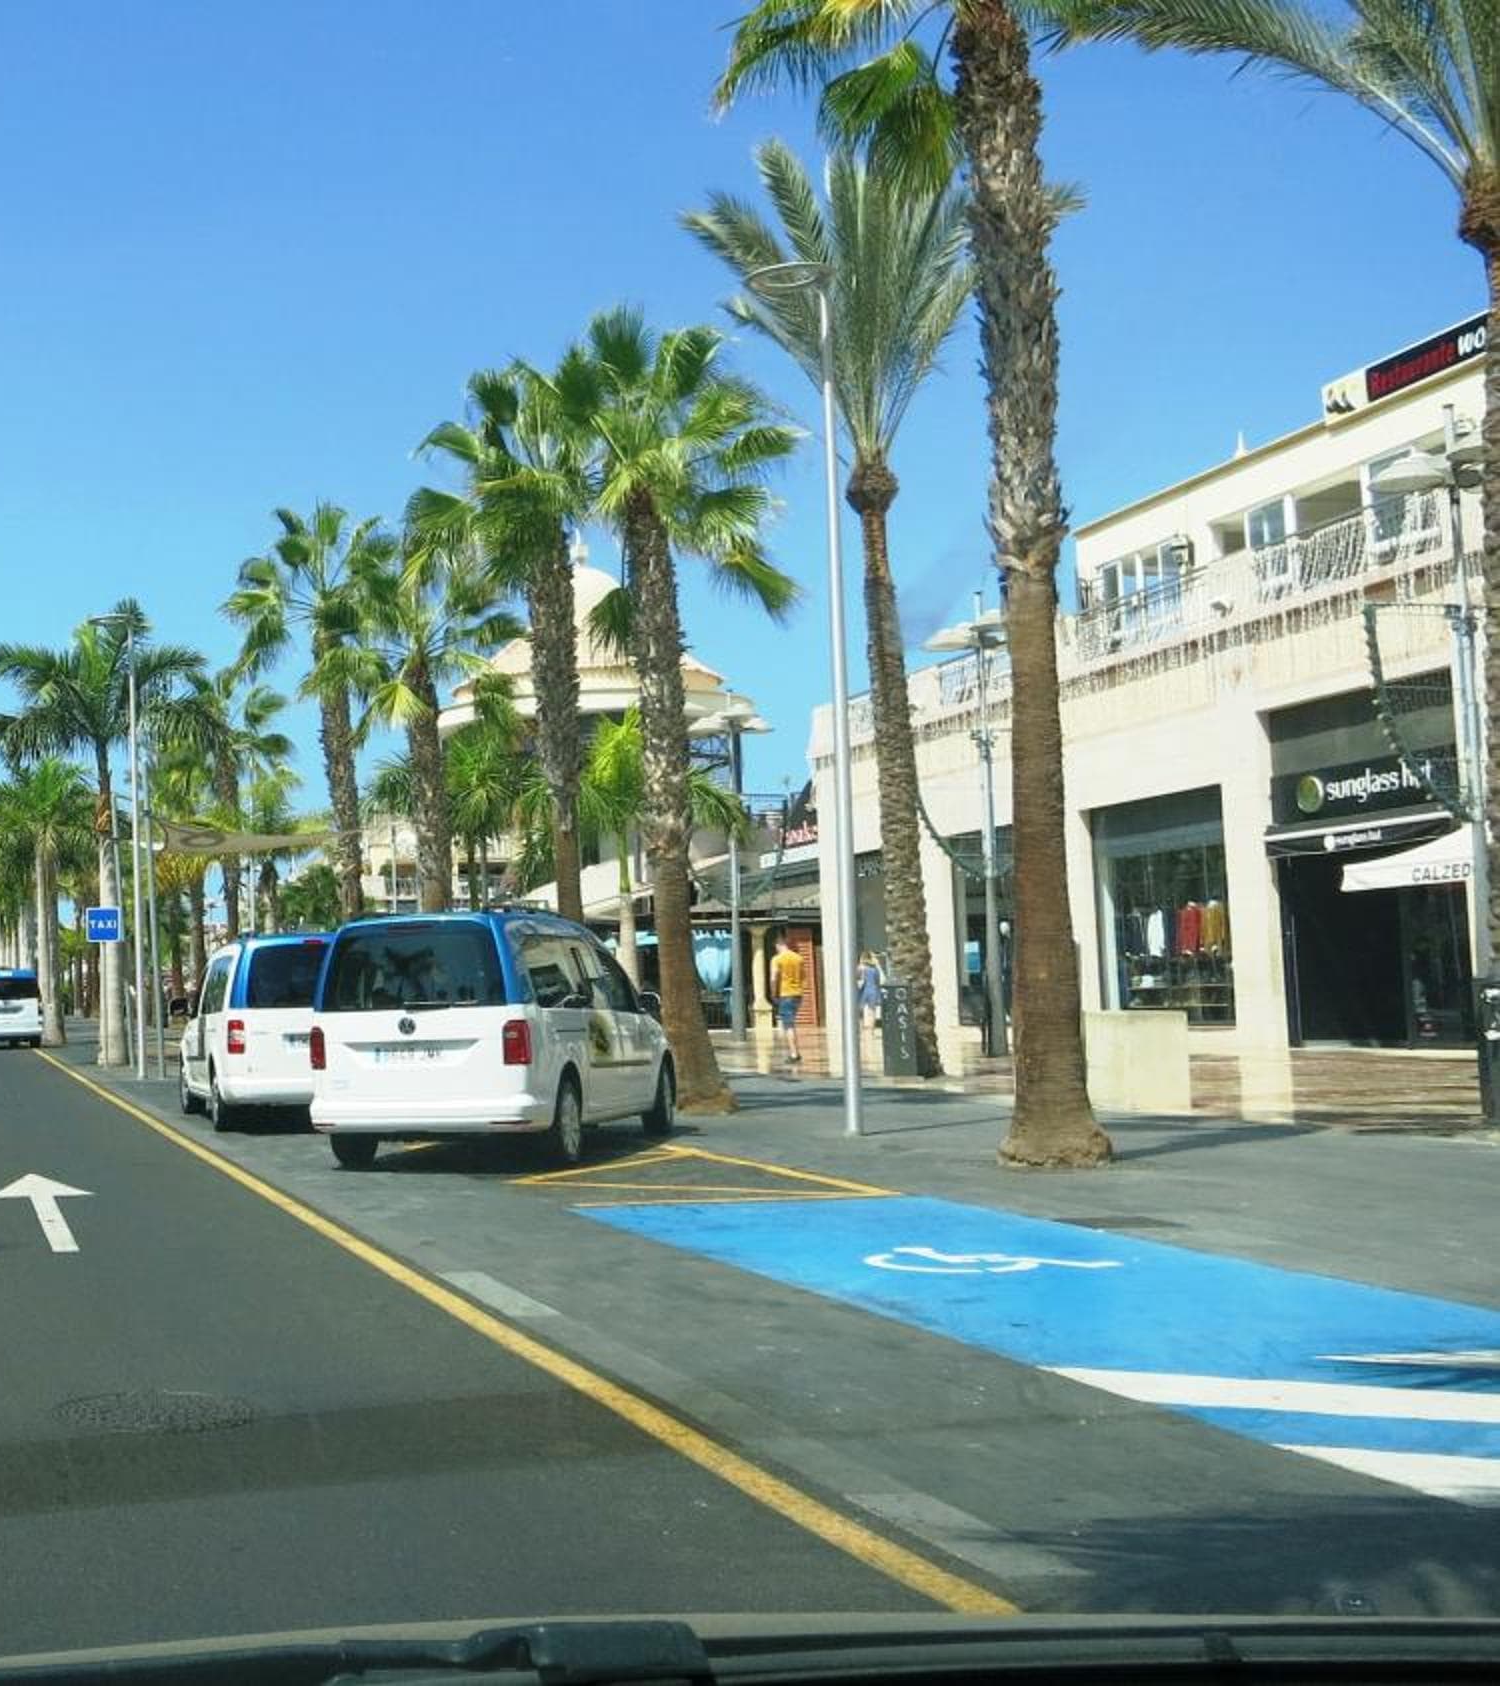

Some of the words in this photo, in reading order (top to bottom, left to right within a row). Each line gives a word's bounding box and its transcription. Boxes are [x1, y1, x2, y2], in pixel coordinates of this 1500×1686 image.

[1457, 325, 1488, 356] WO
[1325, 767, 1399, 803] sunglass
[1411, 862, 1472, 882] CALZED
[89, 919, 117, 929] TAXI
[895, 986, 910, 1060] OASIS
